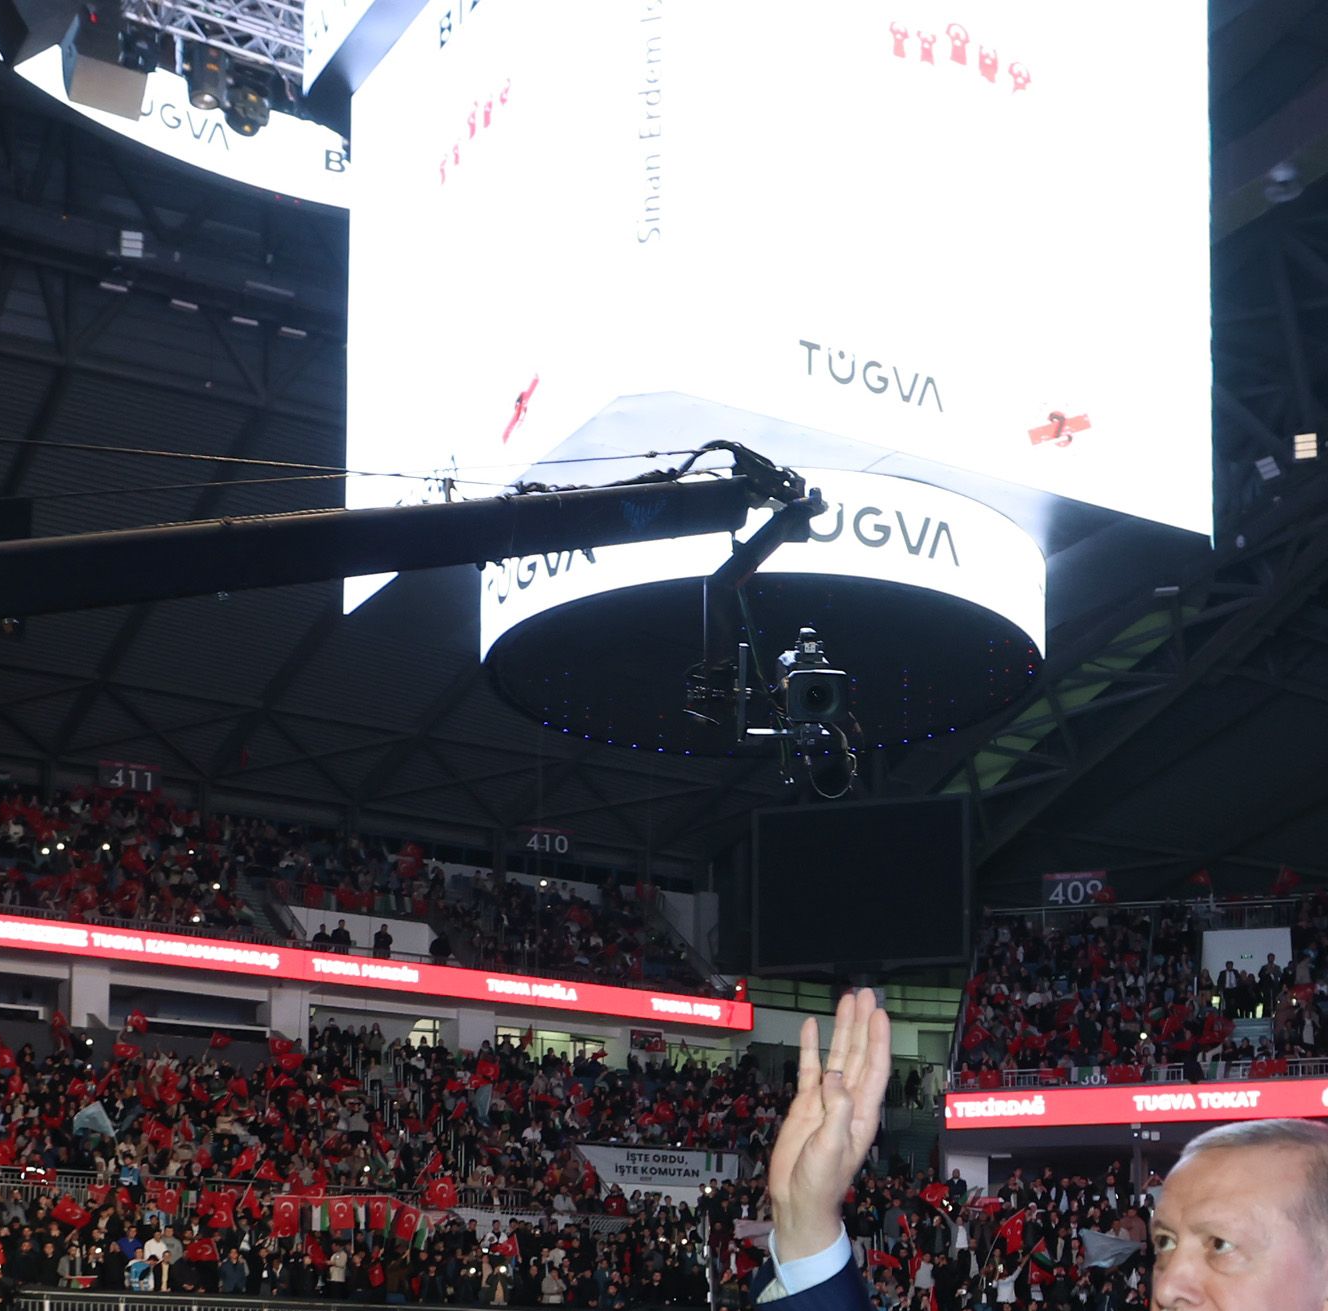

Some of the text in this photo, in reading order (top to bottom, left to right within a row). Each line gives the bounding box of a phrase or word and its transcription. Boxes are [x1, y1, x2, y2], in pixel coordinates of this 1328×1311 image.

[637, 153, 661, 244] Sinan
[526, 833, 569, 854] 410
[1133, 1091, 1261, 1111] TUGVA TOKAT
[626, 1151, 688, 1165] İŞTE ORDU,
[615, 1163, 700, 1177] İŞTE KOMUTAN
